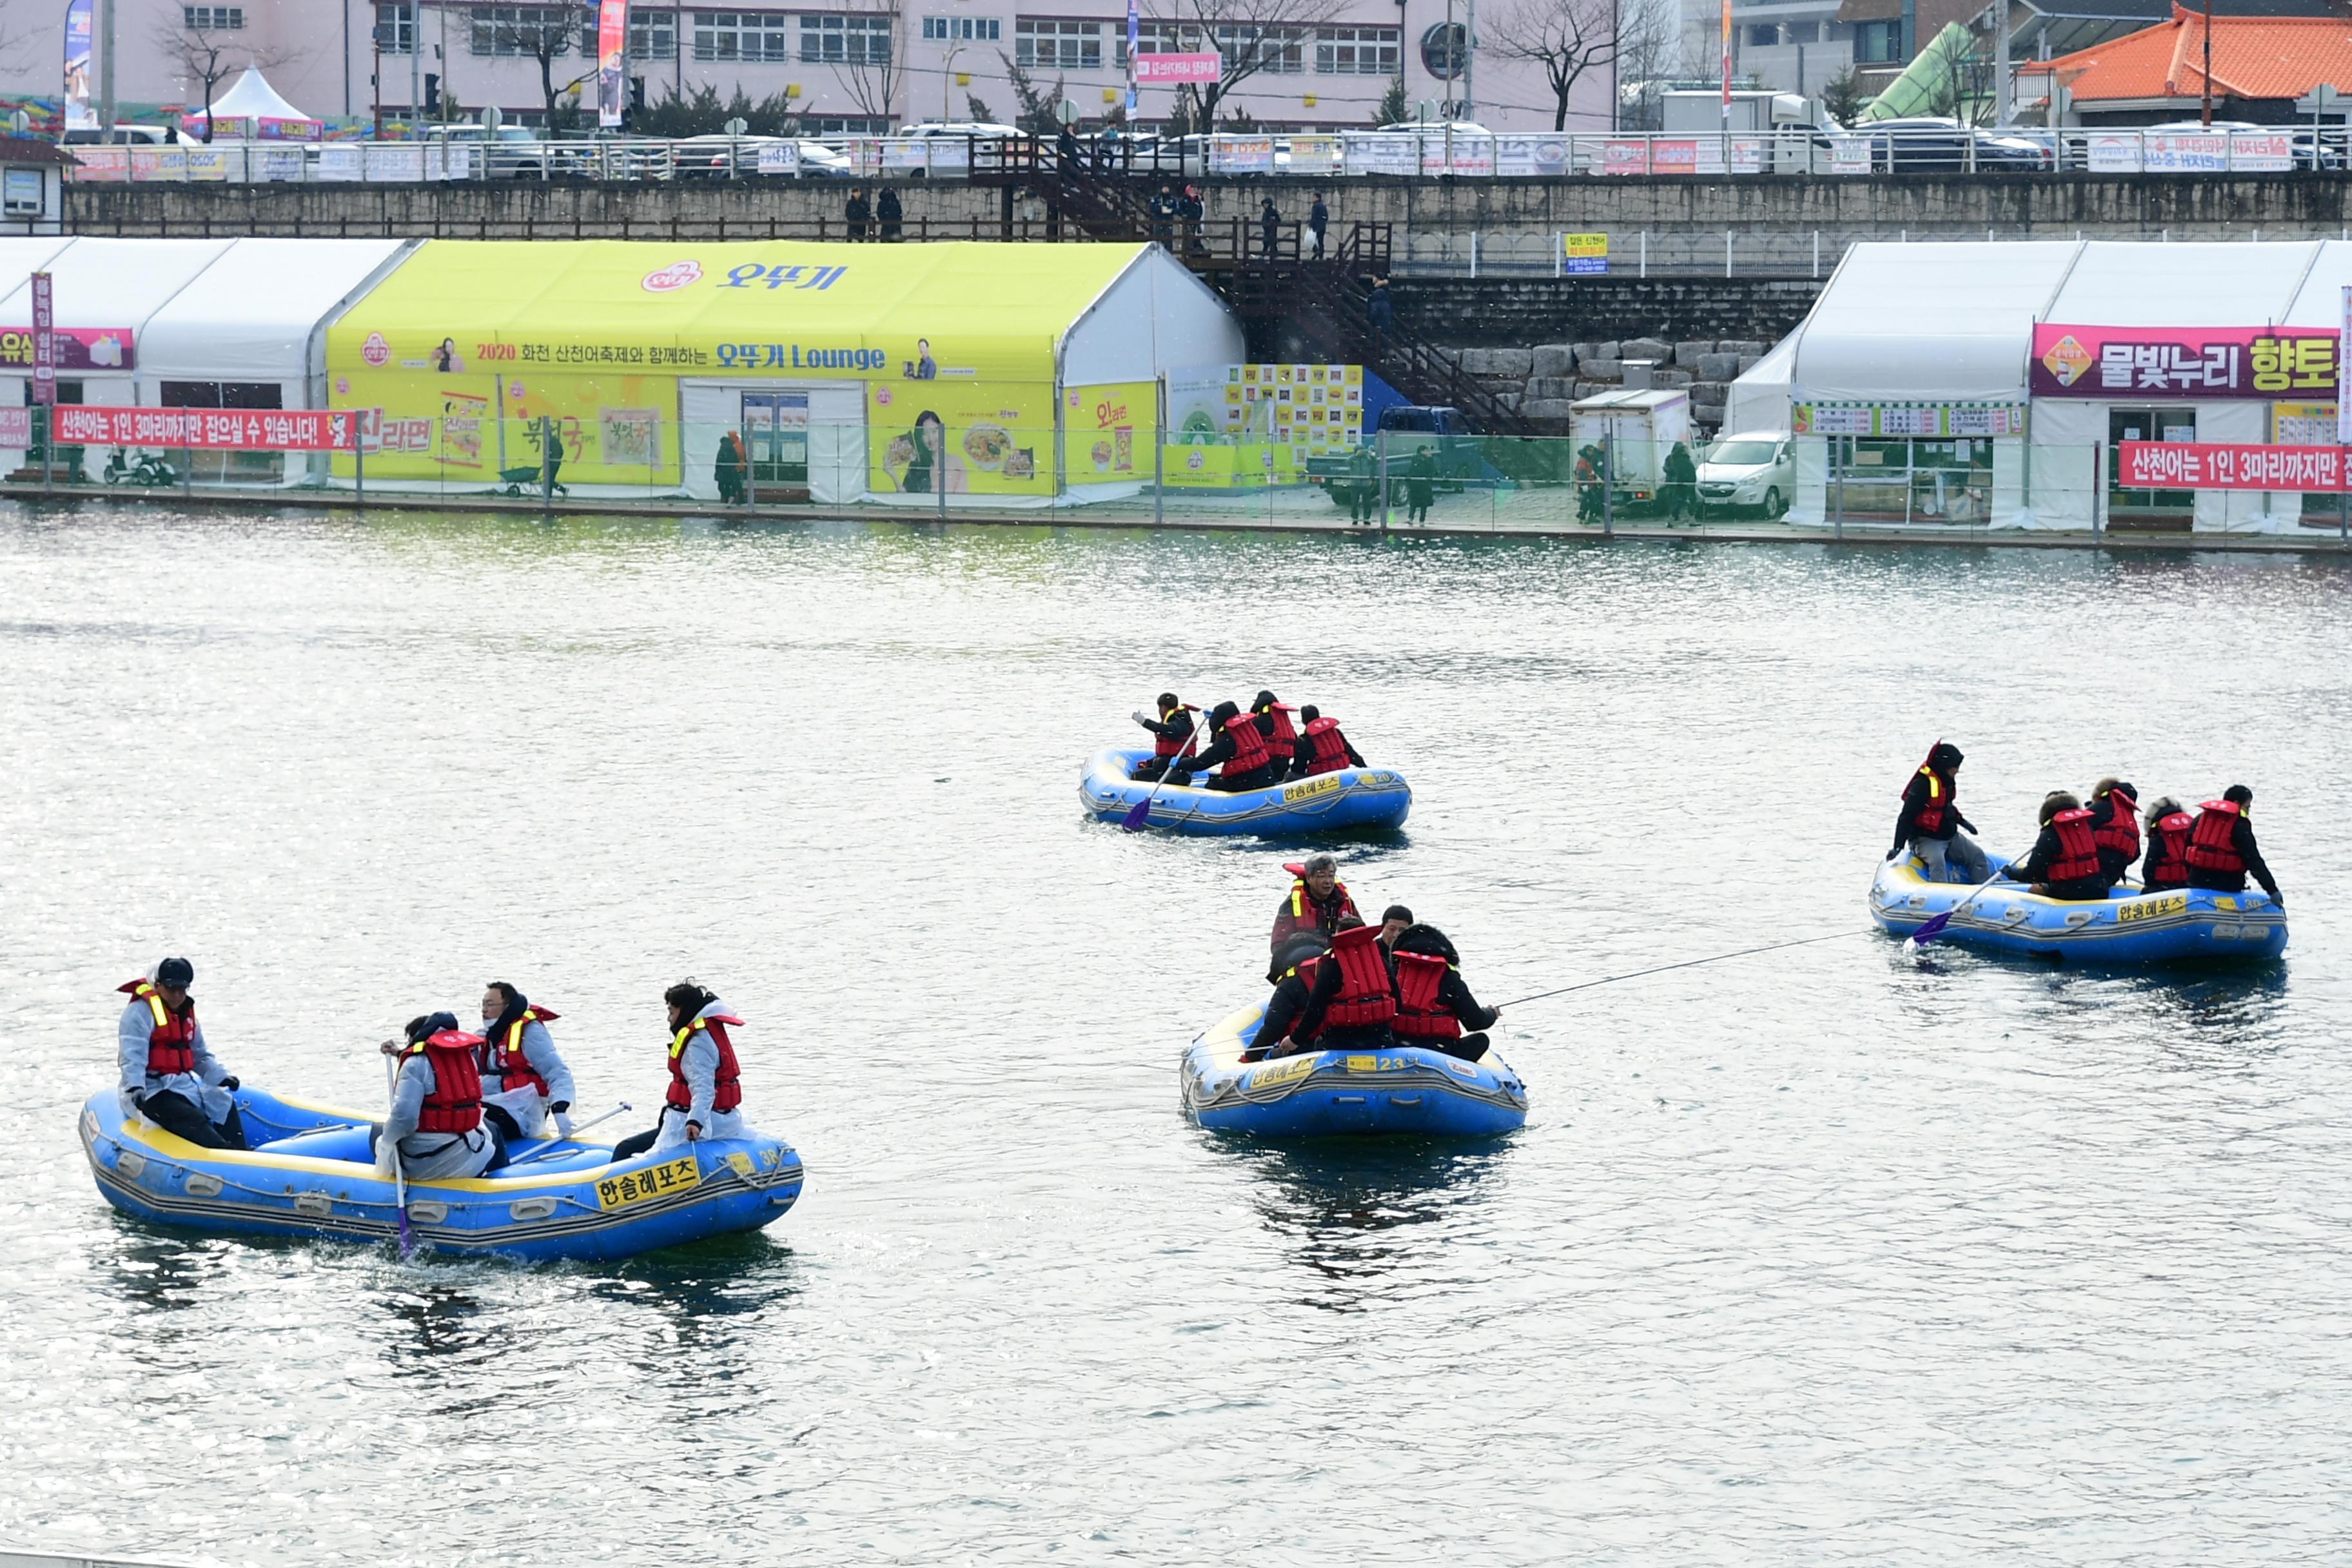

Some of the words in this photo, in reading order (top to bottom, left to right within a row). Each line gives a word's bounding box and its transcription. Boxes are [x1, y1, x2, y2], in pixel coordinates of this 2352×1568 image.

[716, 263, 848, 290] 오뚜기
[477, 344, 515, 360] 2020
[522, 344, 549, 362] 화천
[556, 344, 643, 364] 산천어축제와
[649, 346, 707, 366] 함께하는
[716, 344, 783, 368] 오뚜기
[792, 344, 885, 371] Lounge
[2101, 345, 2238, 389] 물빛누리
[2250, 338, 2340, 391] 향토
[62, 411, 108, 438] 산천어는
[113, 413, 132, 439] 1인
[135, 414, 201, 443] 3마리까지만
[207, 415, 243, 445] 잡으실
[248, 416, 260, 444] 수
[264, 416, 317, 446] 있습니다!
[2132, 449, 2200, 481] 산천어는
[2208, 451, 2233, 483] 1인
[2240, 452, 2337, 486] 3마리까지만
[1380, 1057, 1404, 1070] 23
[600, 1159, 696, 1206] 한솔레포츠
